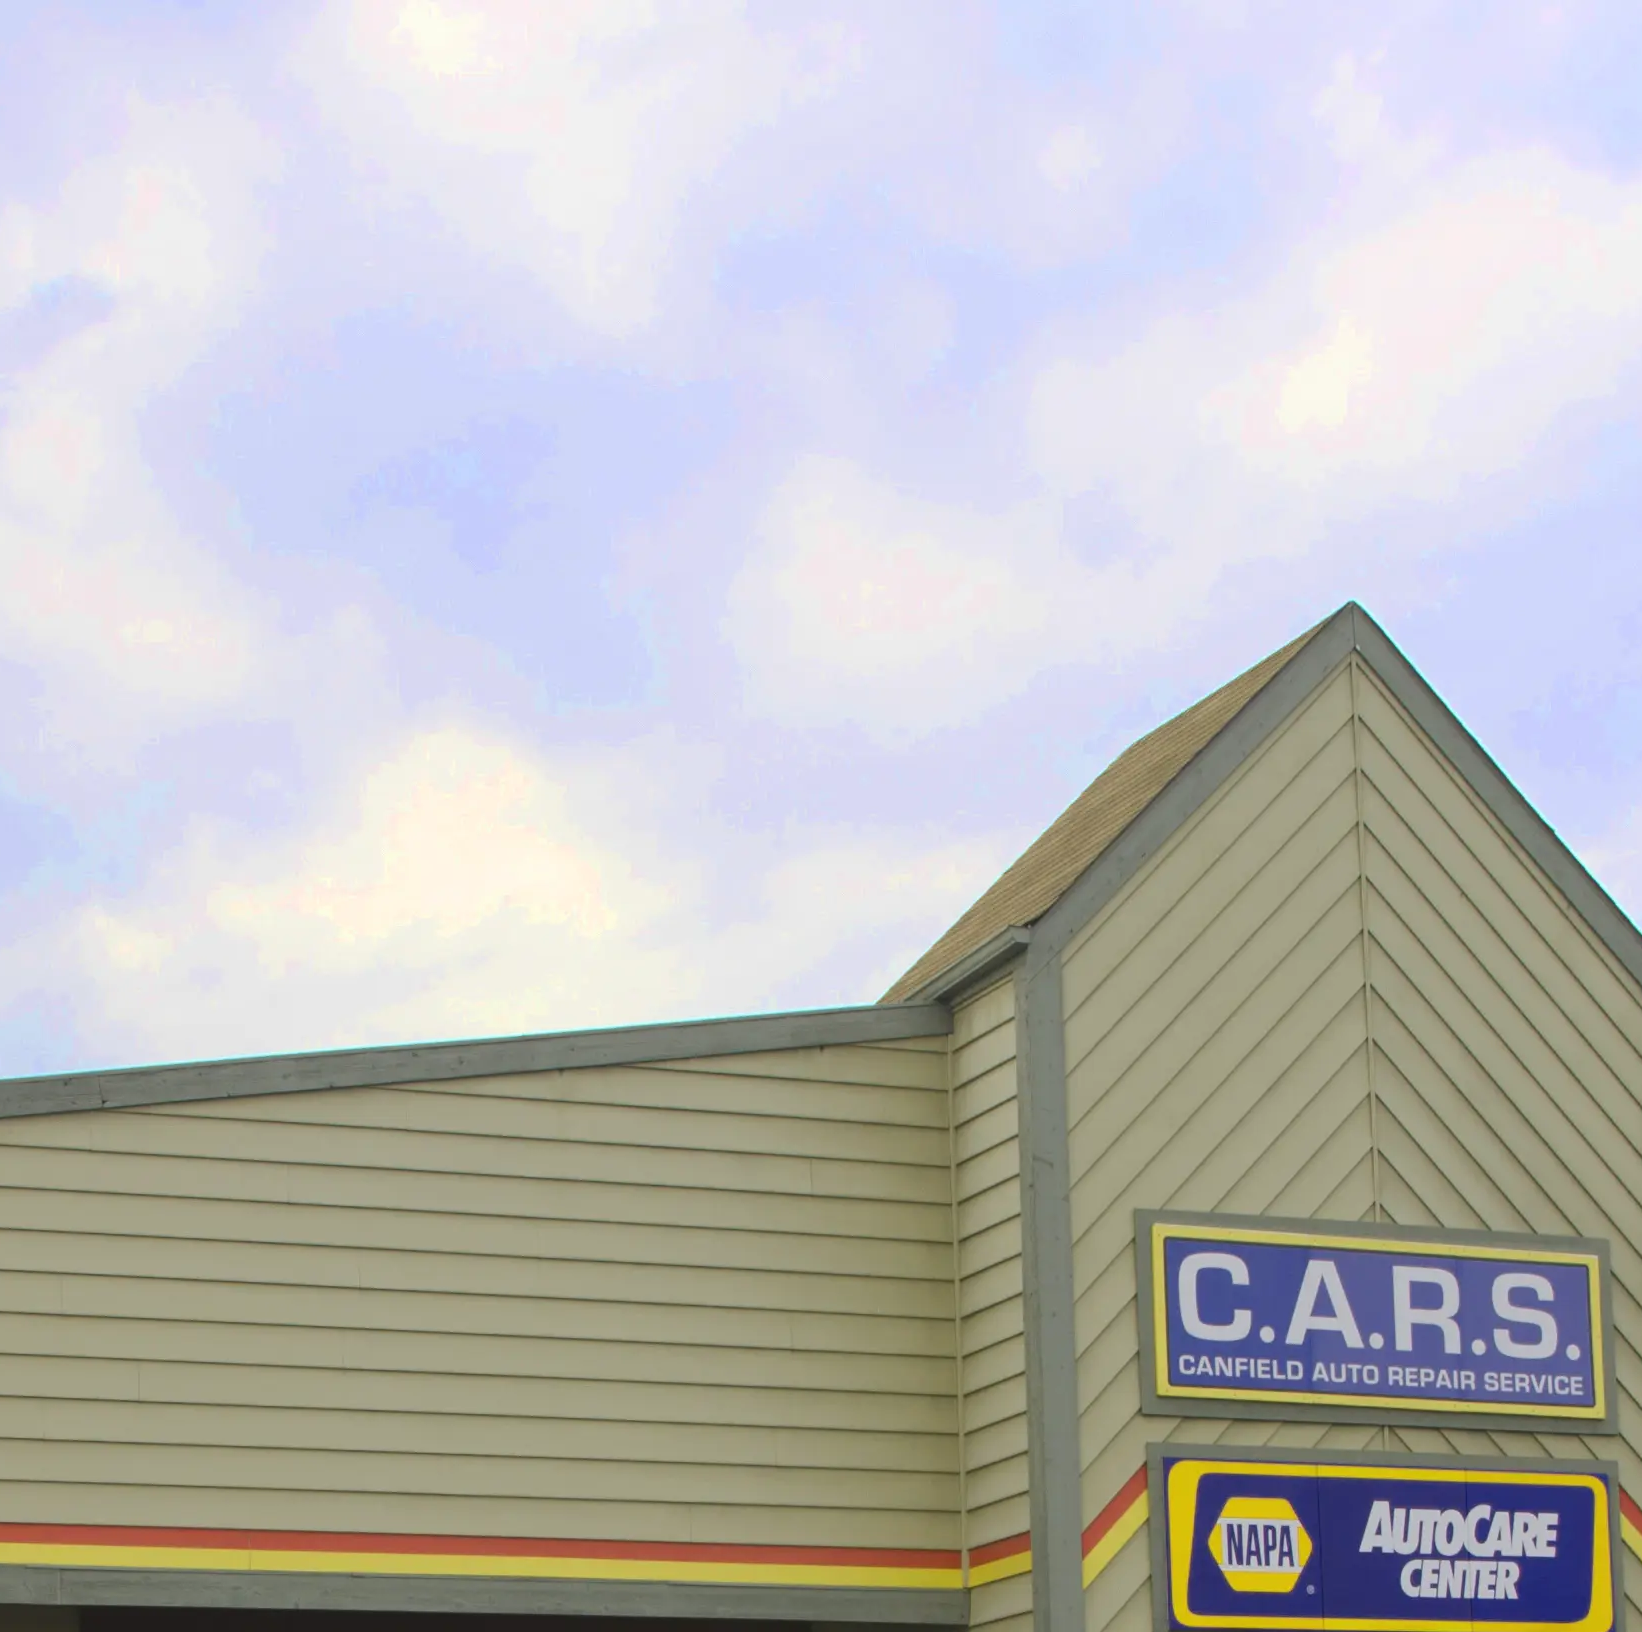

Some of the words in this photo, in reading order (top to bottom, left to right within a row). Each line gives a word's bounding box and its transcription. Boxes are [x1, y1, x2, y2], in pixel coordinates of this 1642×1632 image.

[1177, 1251, 1582, 1361] C.A.R.S.
[1178, 1354, 1305, 1381] CANFIELD
[1312, 1361, 1380, 1386] AUTO
[1388, 1367, 1477, 1391] REPAIR
[1483, 1371, 1584, 1396] SERVICE
[1227, 1522, 1296, 1568] NAPA
[1400, 1559, 1520, 1600] CENTER
